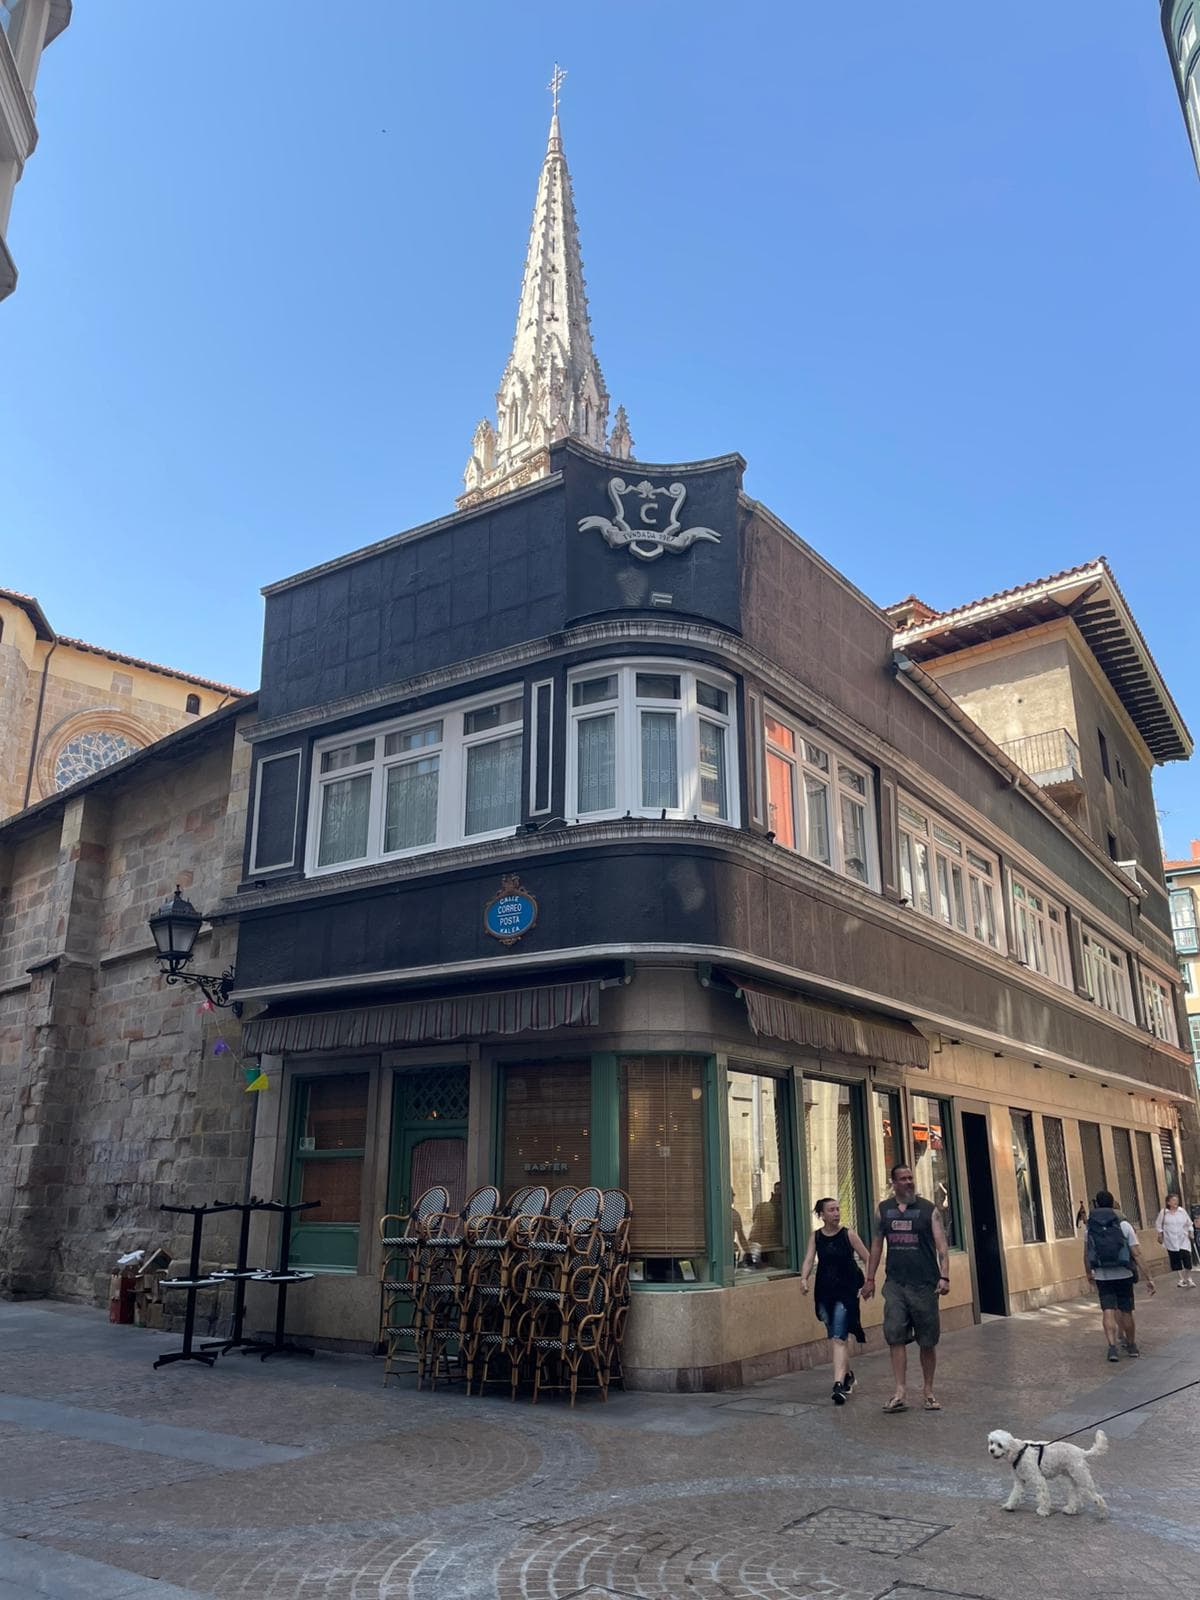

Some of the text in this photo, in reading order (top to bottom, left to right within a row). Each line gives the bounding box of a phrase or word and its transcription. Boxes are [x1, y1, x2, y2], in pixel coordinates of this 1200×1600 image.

[640, 503, 658, 524] C
[499, 895, 521, 905] CALLE
[497, 903, 522, 914] CORREO
[499, 915, 520, 926] POSTA
[499, 926, 521, 934] KALEA
